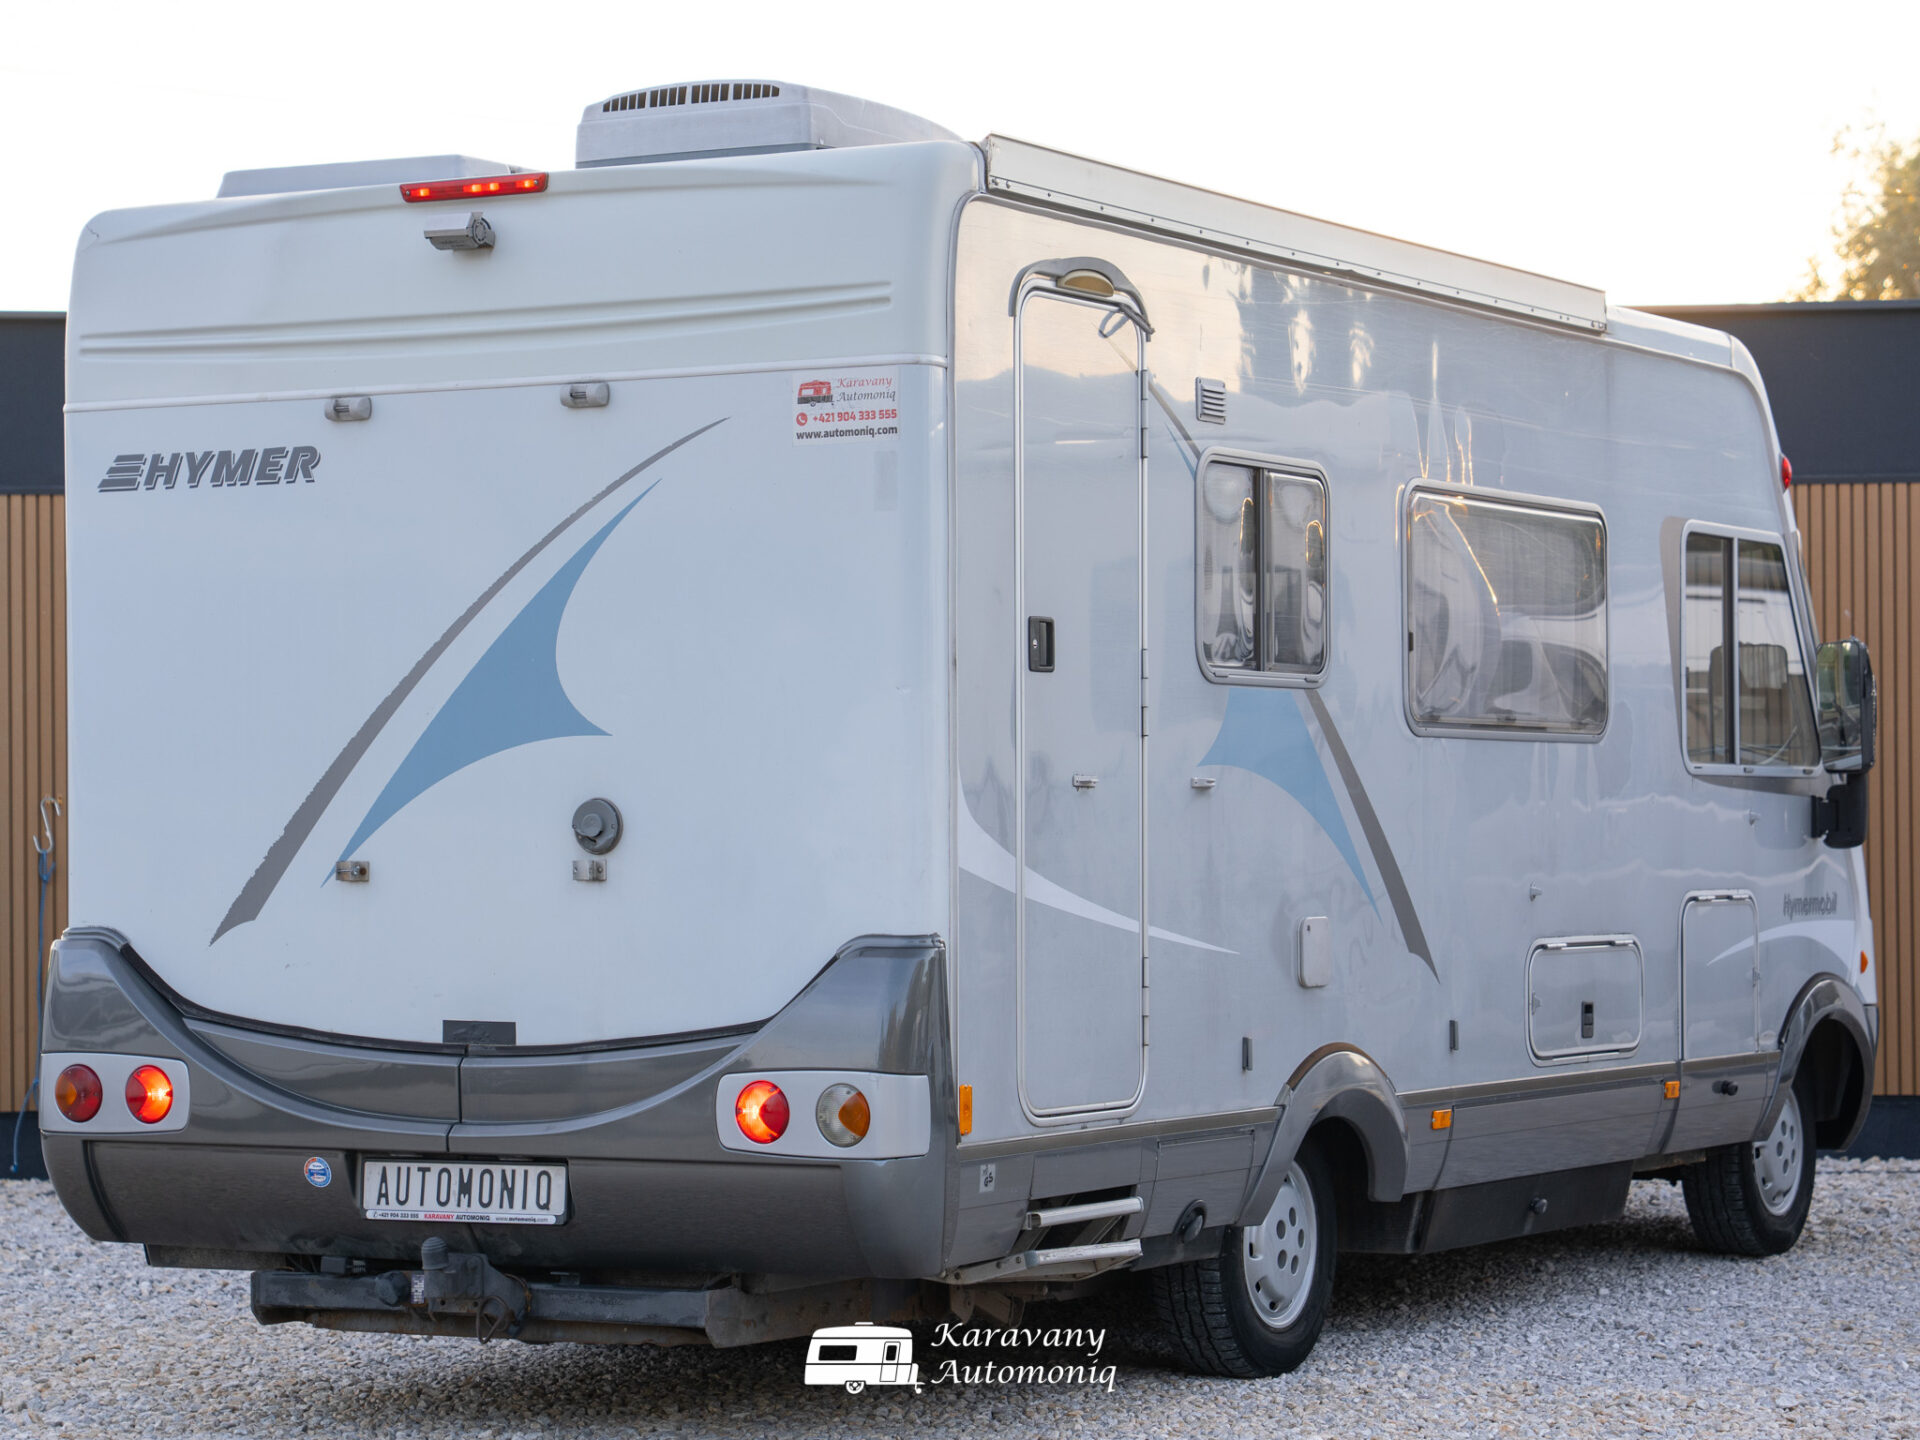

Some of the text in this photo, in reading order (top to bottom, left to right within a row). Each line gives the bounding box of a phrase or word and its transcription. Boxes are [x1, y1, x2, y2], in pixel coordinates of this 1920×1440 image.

[836, 377, 893, 389] Karavany
[836, 389, 896, 402] Automoniq
[813, 409, 897, 423] +421 904 333 555
[796, 425, 898, 440] www.automoniq.com
[143, 445, 321, 491] HYMER
[1783, 891, 1838, 920] Hymermobil
[376, 1166, 551, 1211] AUTOMONIQ
